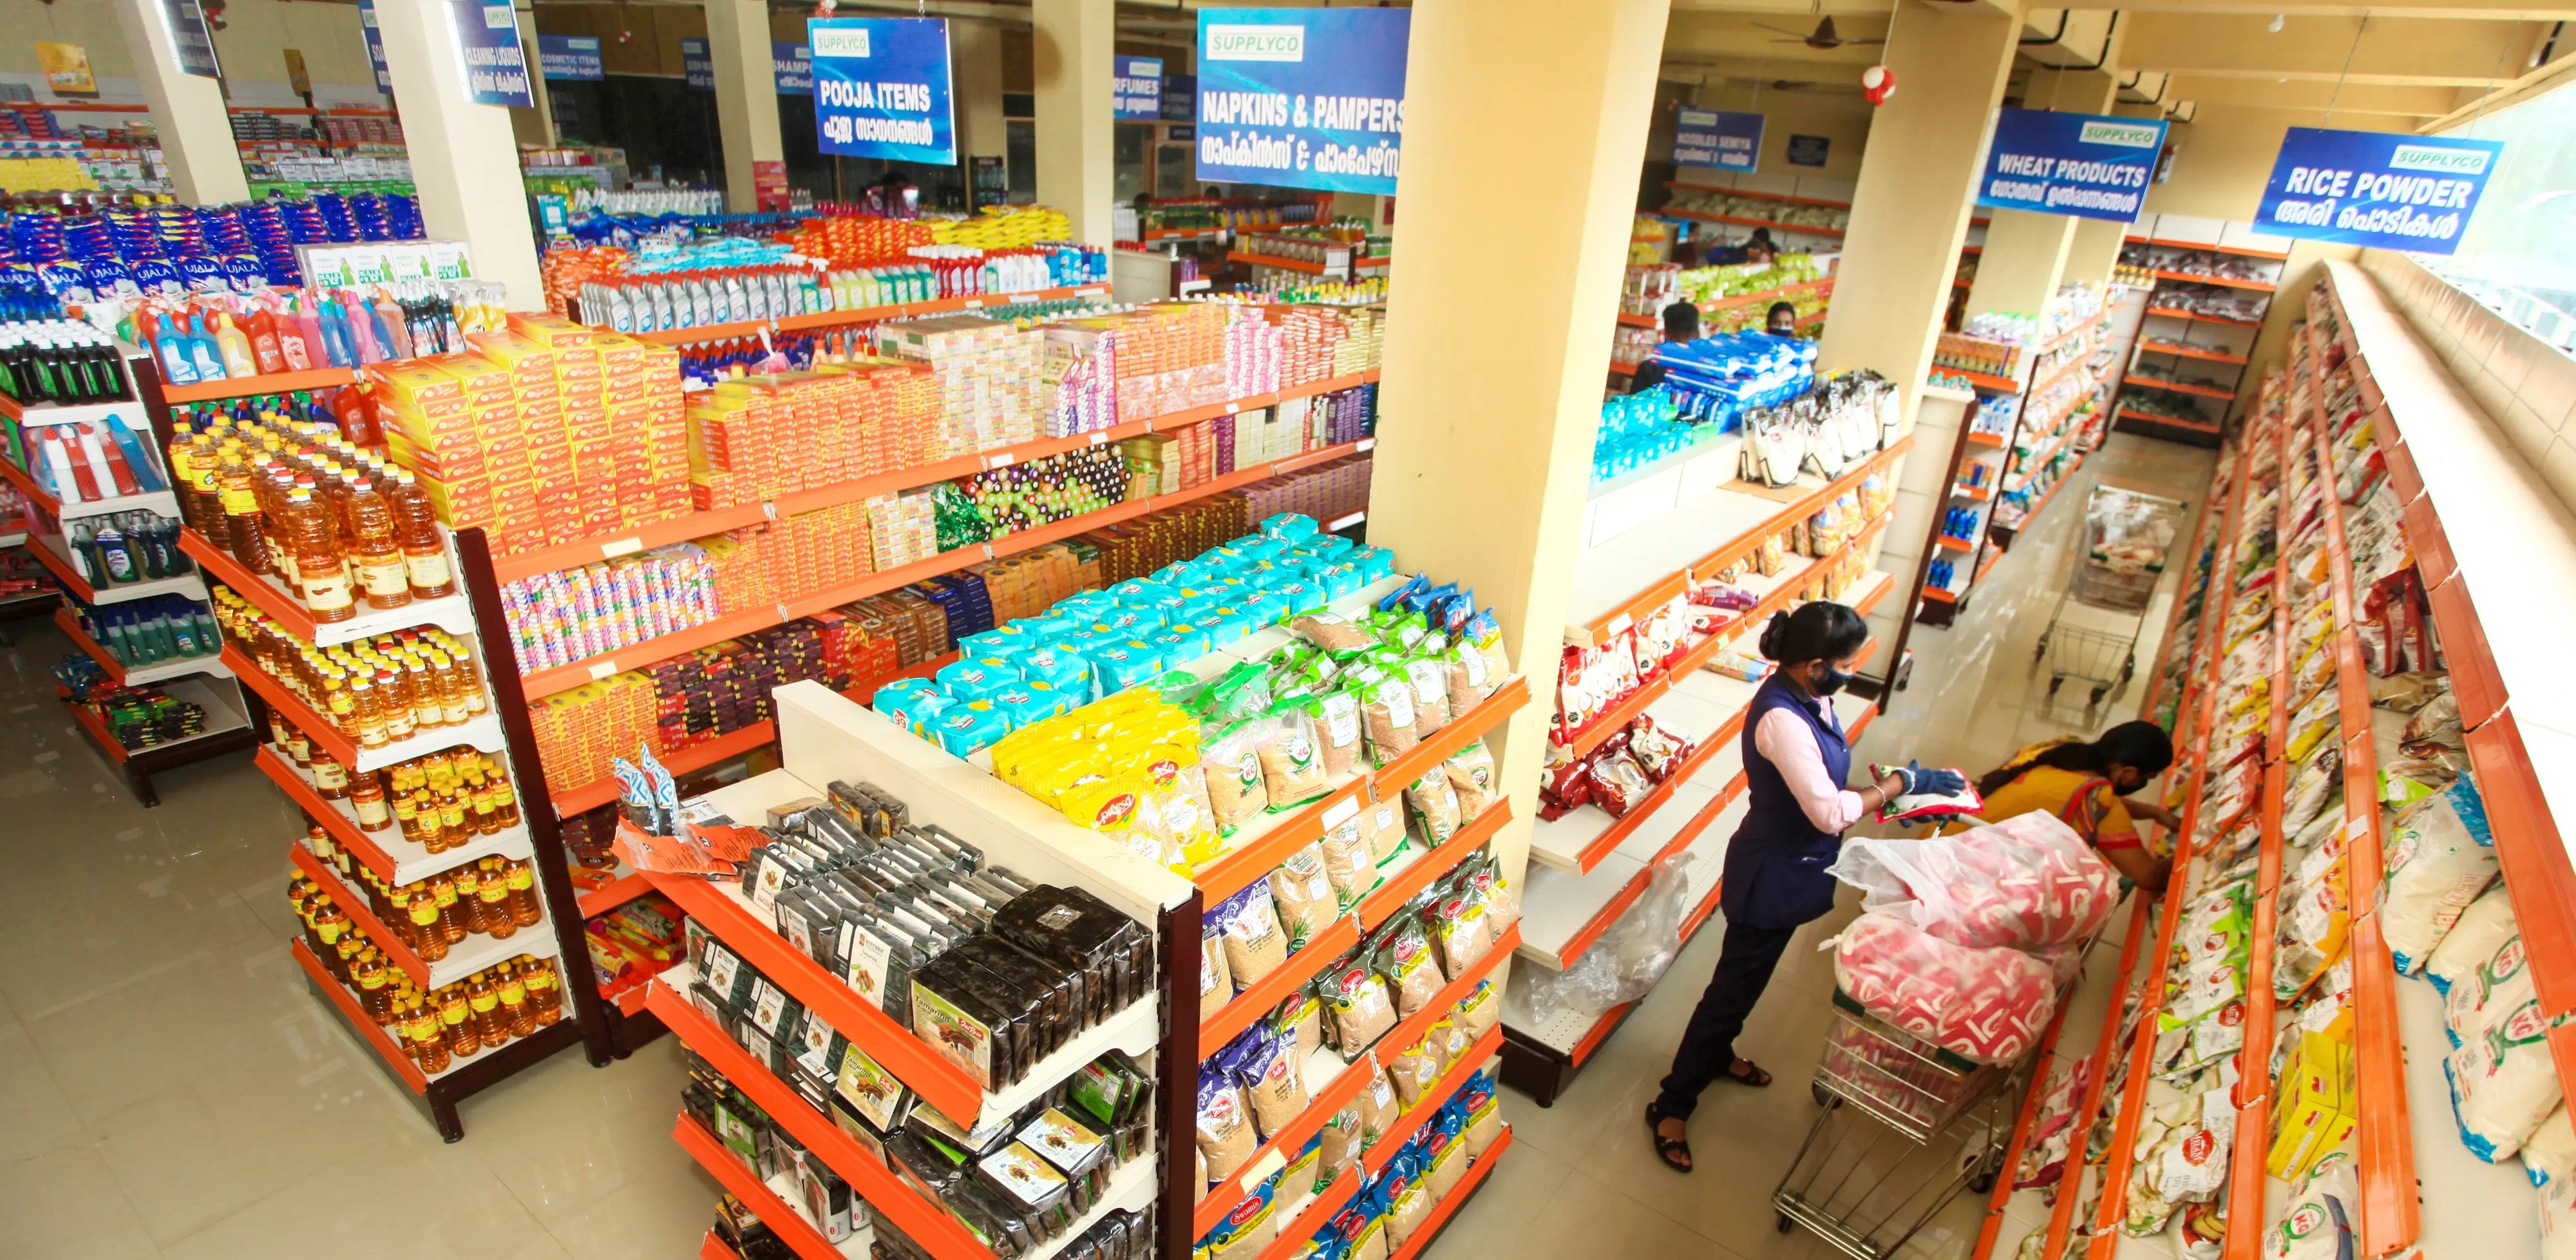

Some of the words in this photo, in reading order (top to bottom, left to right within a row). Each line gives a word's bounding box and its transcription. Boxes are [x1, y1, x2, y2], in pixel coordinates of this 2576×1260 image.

[817, 36, 866, 50] SUPPLYCO
[1213, 36, 1299, 52] SUPPLYCO
[466, 47, 497, 66] CLEANING
[497, 48, 522, 67] LIQUIDS
[820, 80, 875, 109] POOJA
[877, 82, 931, 112] ITEMS
[1203, 91, 1288, 127] NAPKINS
[1293, 95, 1307, 128] &
[2085, 127, 2154, 143] SUPPLYCO
[2398, 151, 2483, 167] SUPPLYCO
[1998, 154, 2056, 178] WHEAT
[2055, 160, 2146, 189] PRODUCTS
[2284, 167, 2353, 197] RICE
[2351, 173, 2474, 209] POWDER
[90, 267, 124, 279] UJALA
[137, 267, 171, 279] UJALA
[185, 263, 218, 274] UJALA
[225, 263, 258, 274] UJALA
[895, 714, 907, 729] 99
[1341, 969, 1363, 993] Swamis
[914, 995, 951, 1023] Tamarind
[2512, 1015, 2533, 1037] KG
[846, 1054, 871, 1078] Tamarind
[1468, 1093, 1486, 1111] Swamis
[1430, 1136, 1446, 1153] Swamis
[2190, 1132, 2206, 1162] MELAM
[1233, 1200, 1260, 1223] Swamis
[1347, 1217, 1364, 1237] Swamis
[2294, 1213, 2311, 1235] KG
